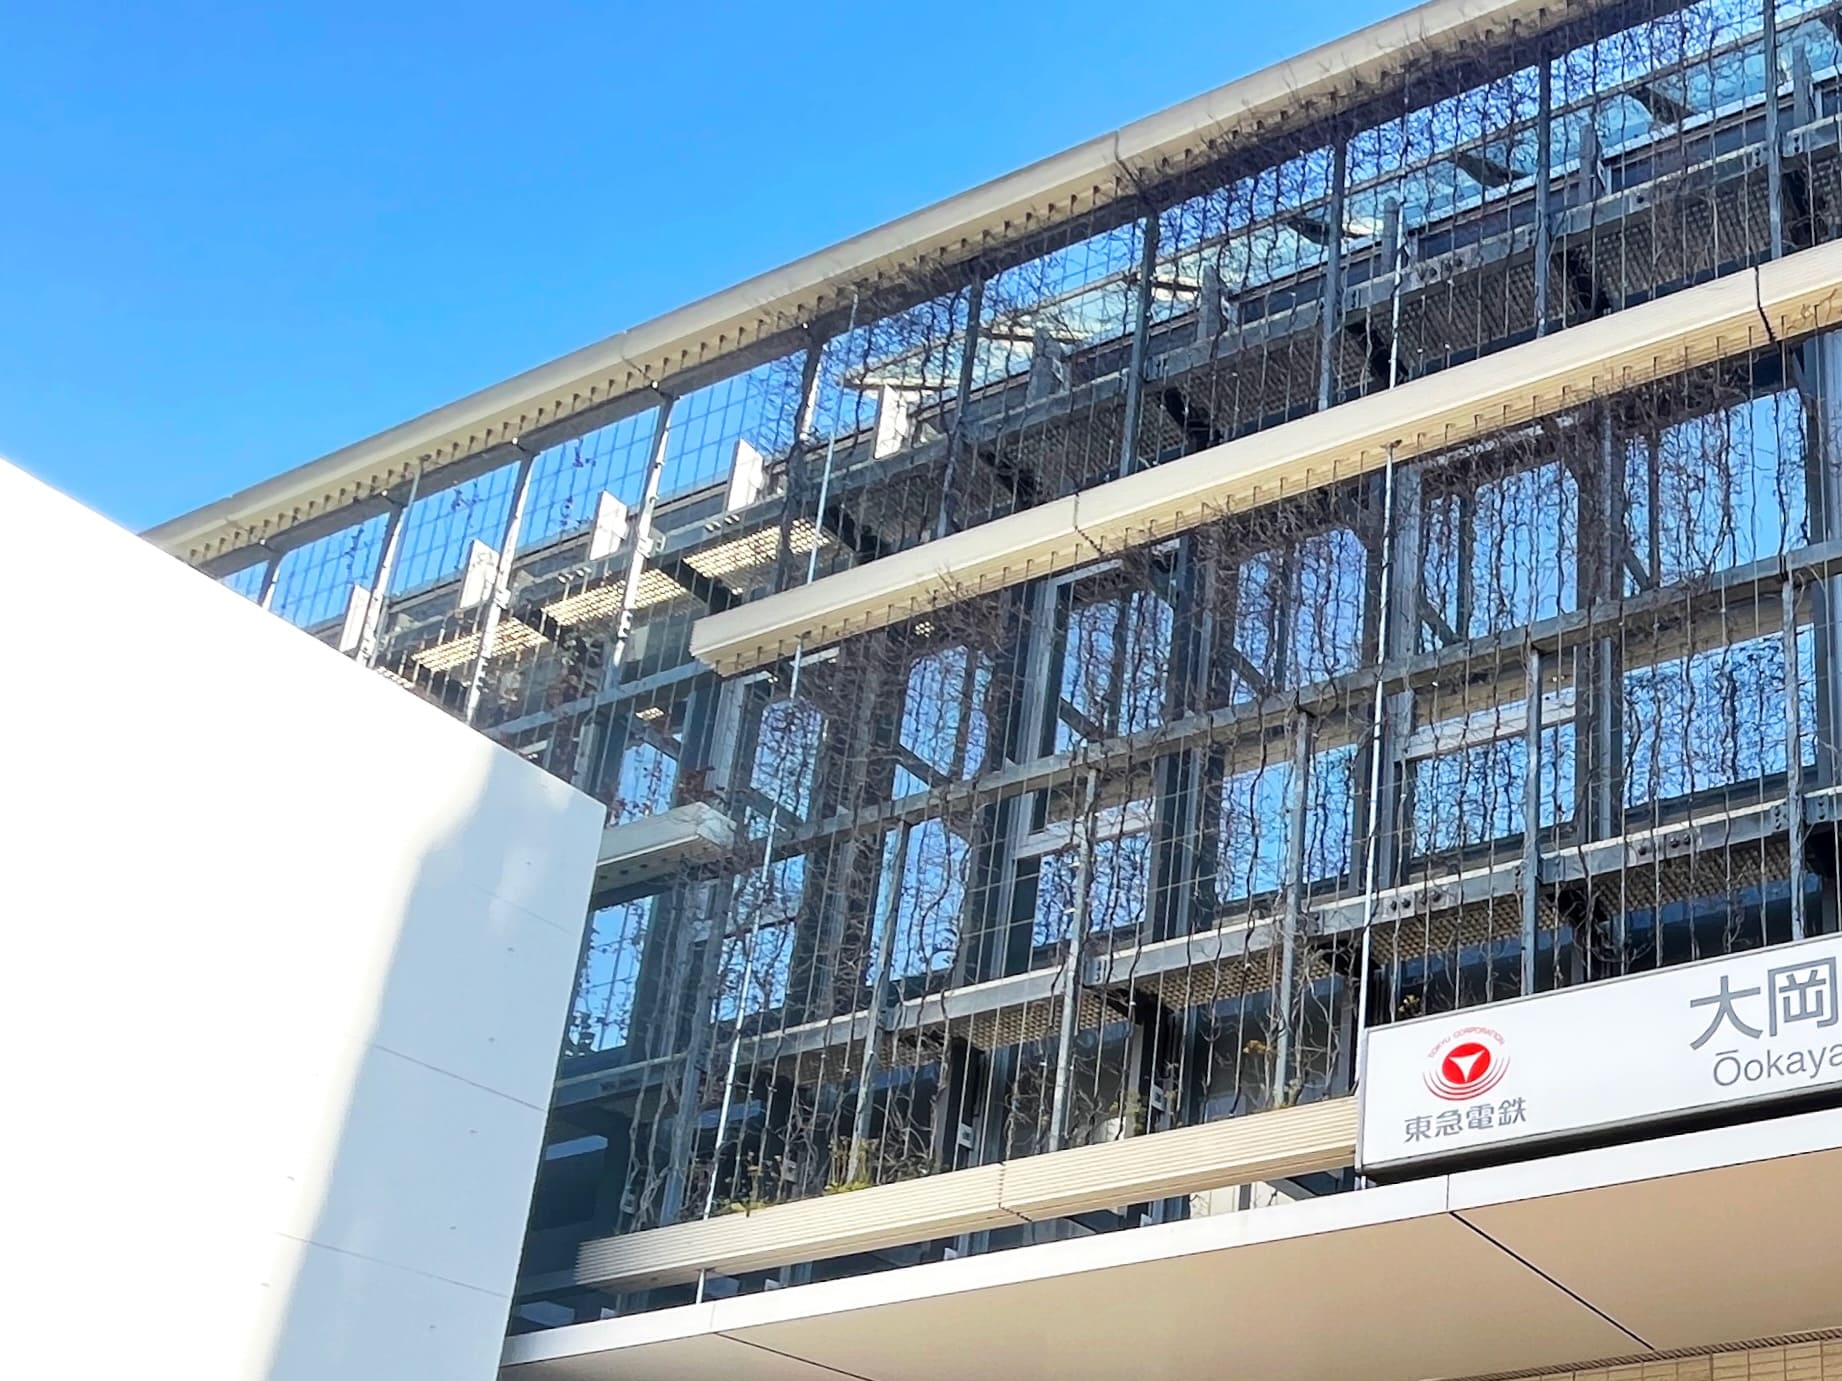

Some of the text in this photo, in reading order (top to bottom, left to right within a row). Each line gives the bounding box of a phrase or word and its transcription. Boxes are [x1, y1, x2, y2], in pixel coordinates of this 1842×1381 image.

[1427, 1025, 1505, 1058] TOKYU CORPORATION
[1403, 1096, 1527, 1143] 東急電鉄
